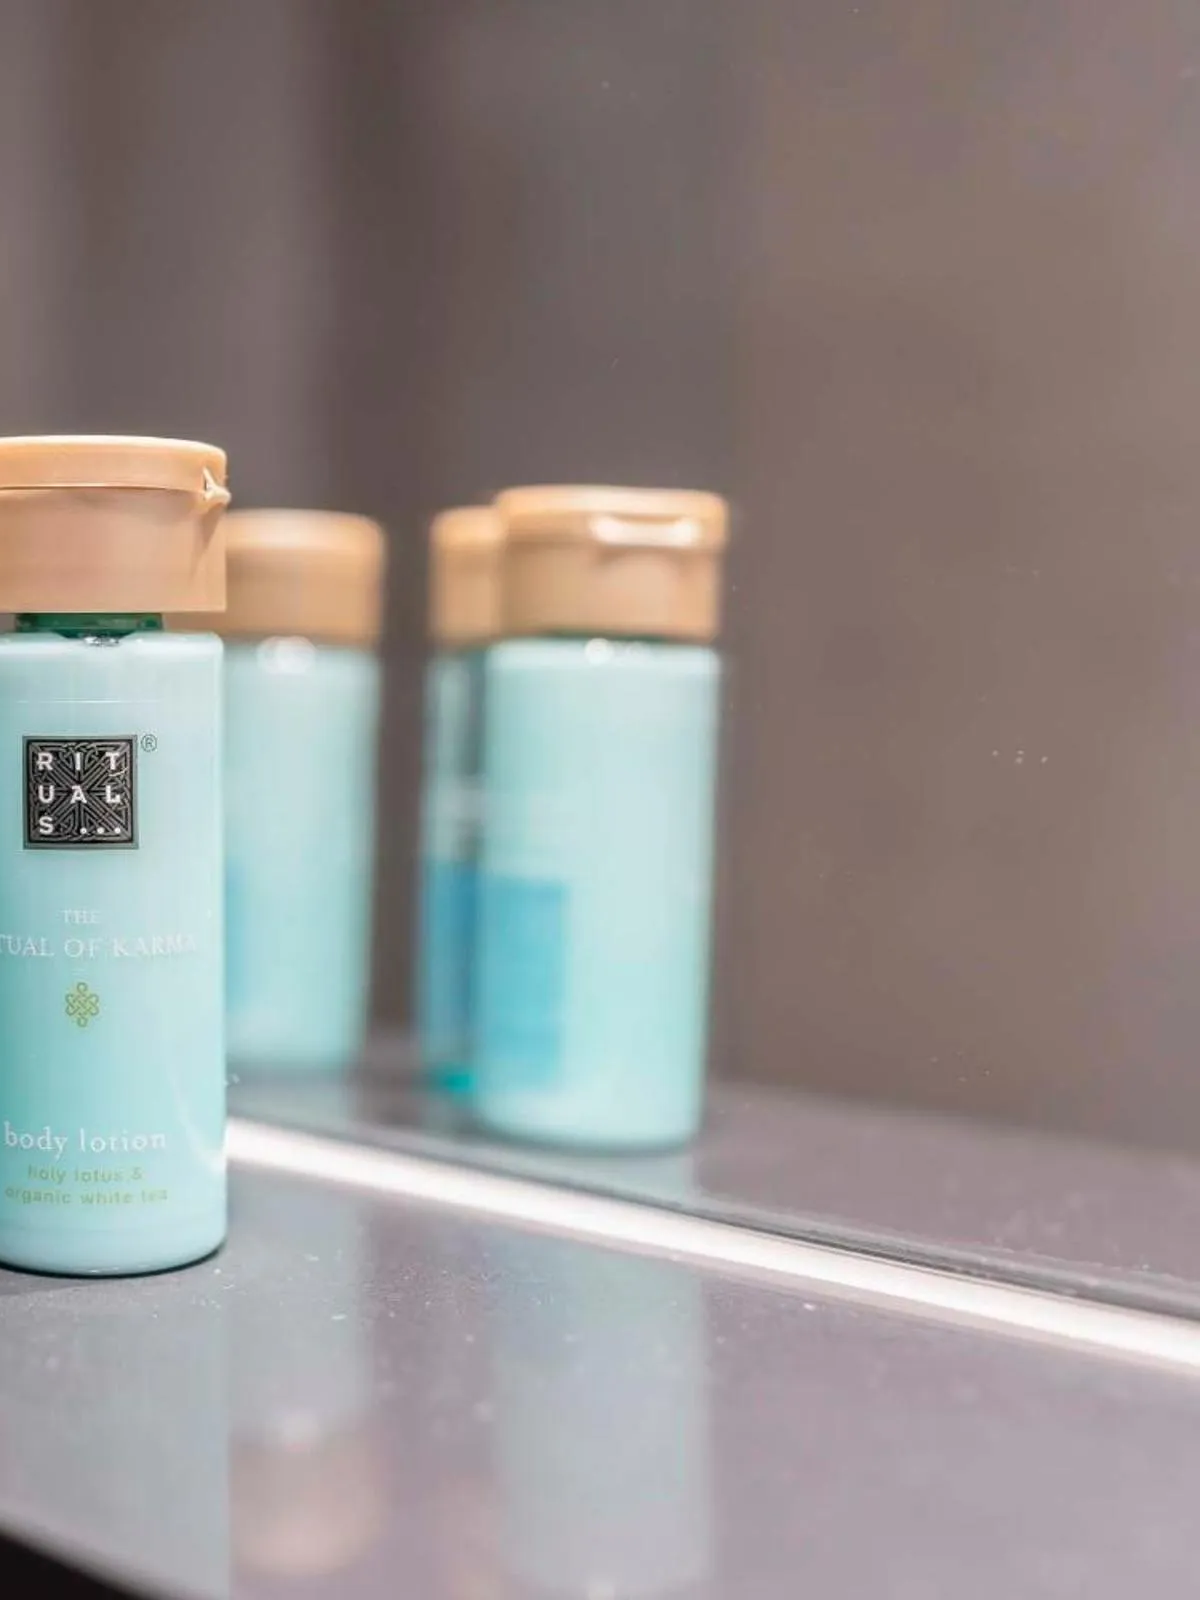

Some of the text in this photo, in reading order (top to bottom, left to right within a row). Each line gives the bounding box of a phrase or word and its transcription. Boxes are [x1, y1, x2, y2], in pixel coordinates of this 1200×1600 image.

[60, 908, 101, 924] THE
[63, 937, 104, 958] OF
[112, 930, 197, 957] KARMA
[3, 1119, 168, 1161] body lotion
[27, 1163, 67, 1184] holy
[73, 1165, 124, 1183] lotus
[4, 1184, 169, 1206] organic white tea
